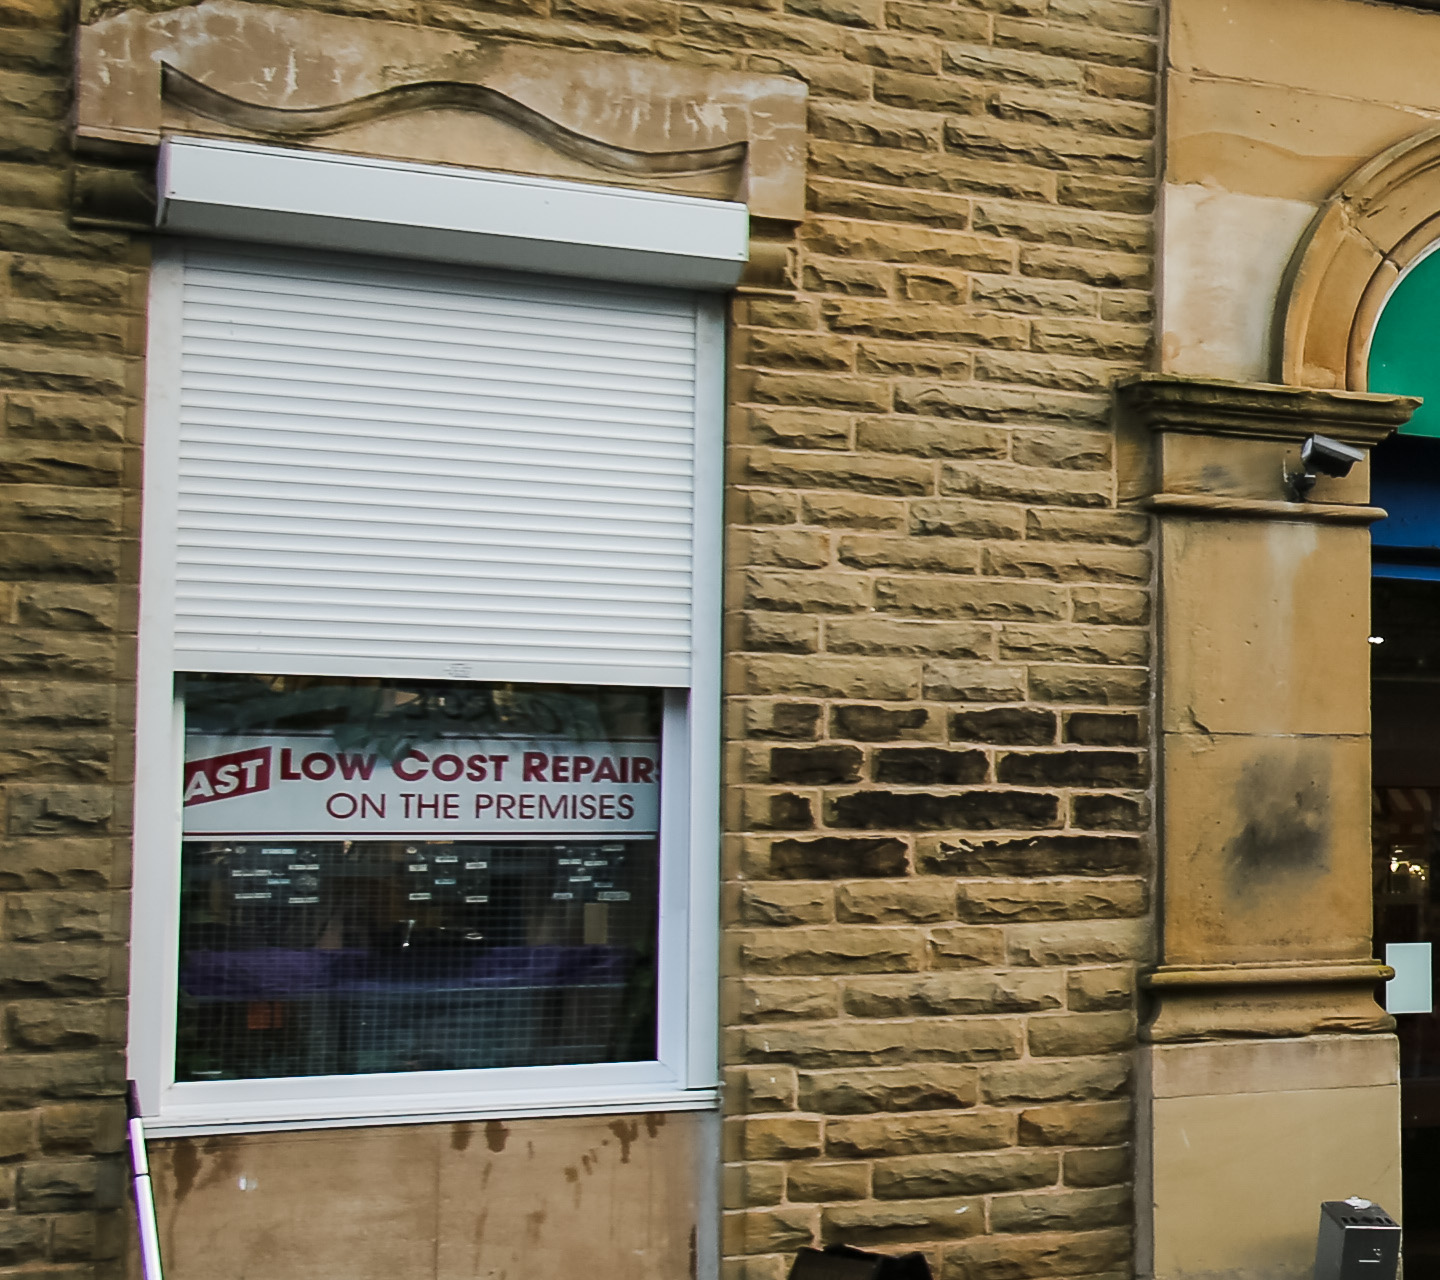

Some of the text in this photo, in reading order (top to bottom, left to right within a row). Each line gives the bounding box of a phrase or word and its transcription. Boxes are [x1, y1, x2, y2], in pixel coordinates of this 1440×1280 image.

[183, 748, 658, 802] AST LOW COST REPAIR
[326, 793, 635, 820] ON THE PREMISES
